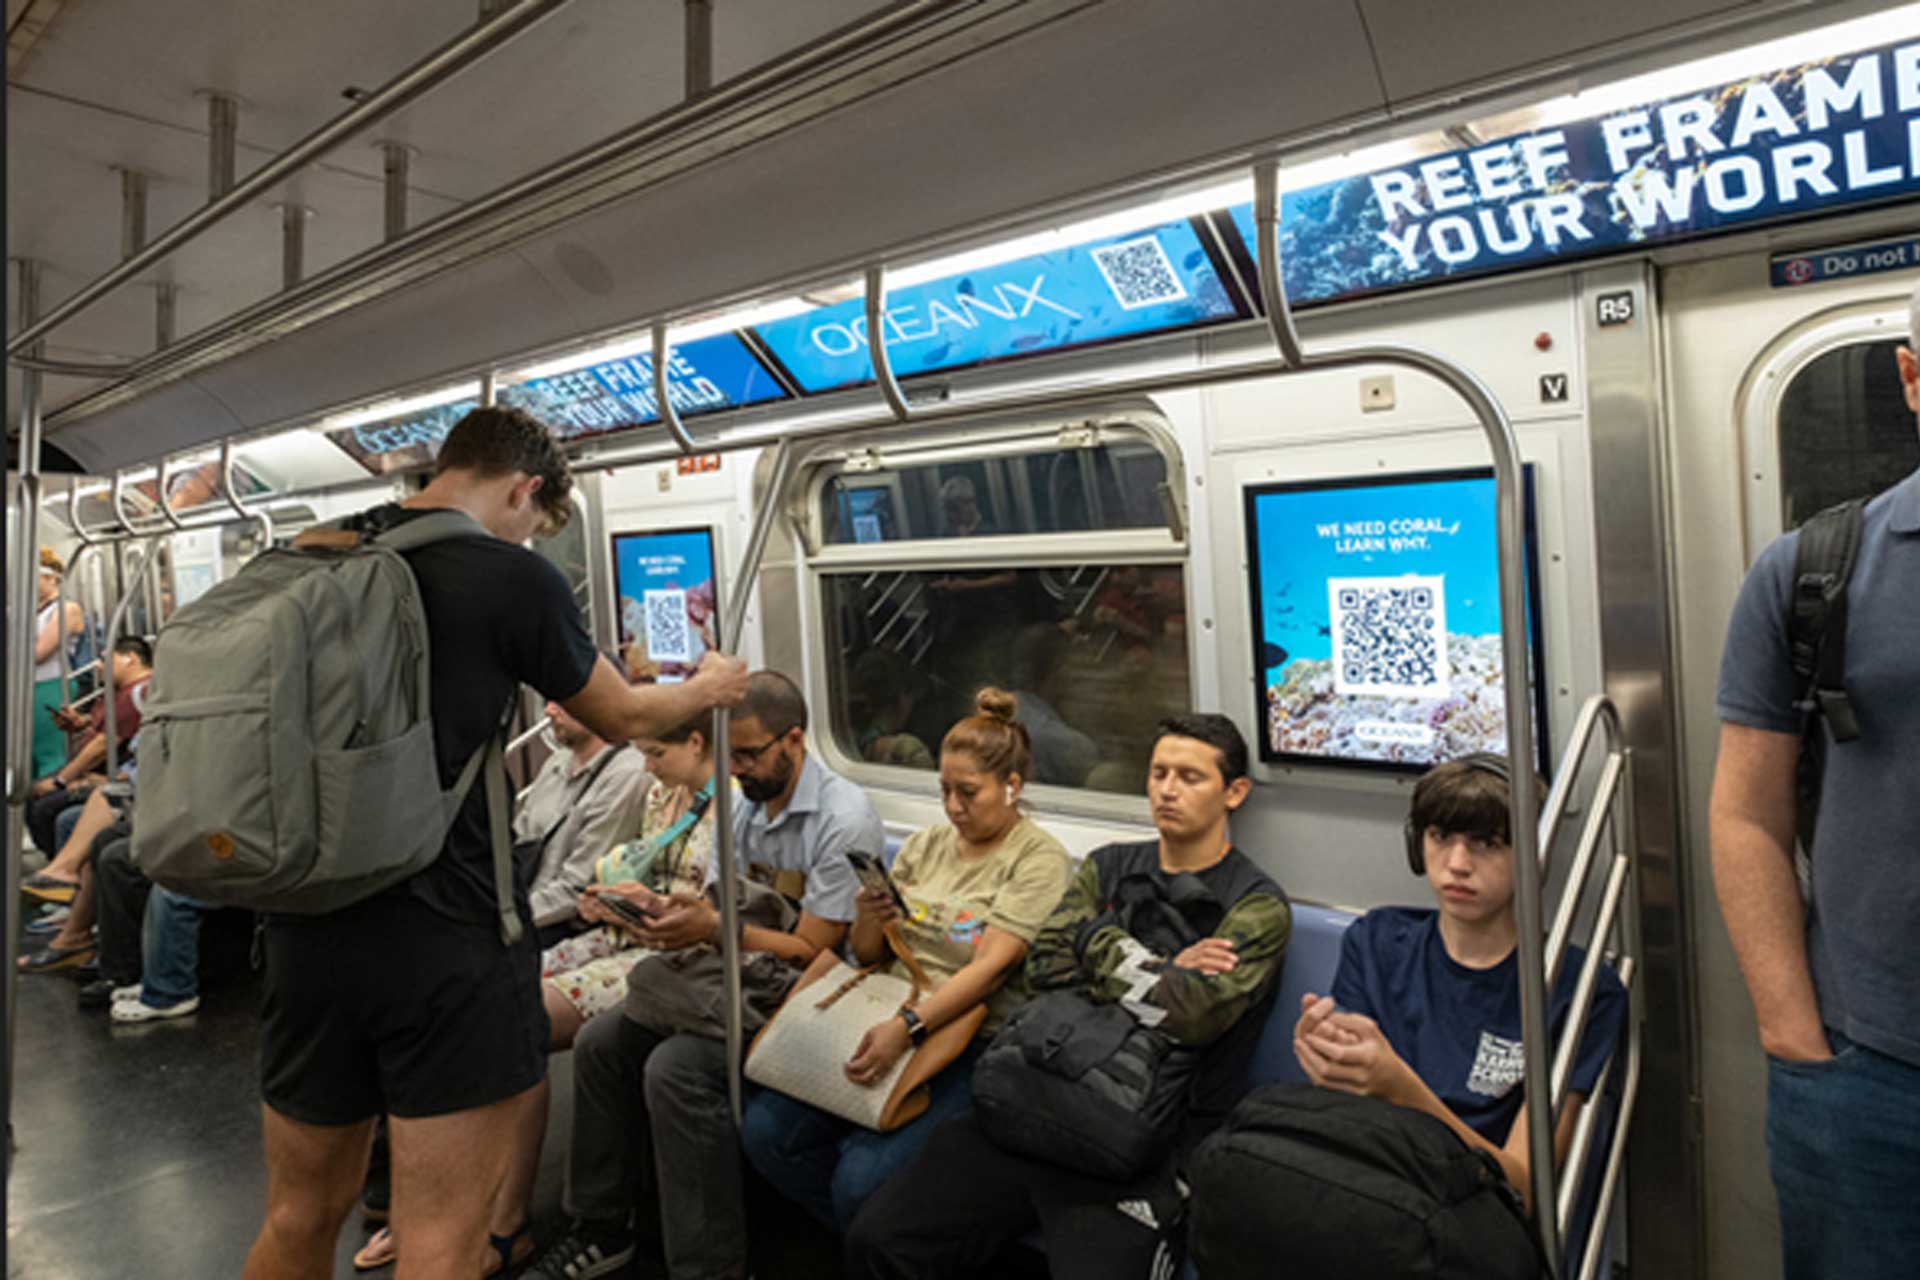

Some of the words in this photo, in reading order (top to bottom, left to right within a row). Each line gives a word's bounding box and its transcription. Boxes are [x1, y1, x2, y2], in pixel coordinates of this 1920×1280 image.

[1370, 131, 1569, 221] REEF
[1378, 193, 1594, 271] YOUR
[1612, 118, 1920, 228] WORL
[1823, 256, 1858, 276] Do
[1864, 246, 1906, 269] not
[1600, 298, 1632, 321] R5
[534, 370, 603, 404] REEF
[1544, 377, 1564, 399] V
[557, 395, 633, 428] YOUR
[1316, 522, 1340, 537] WE
[1344, 520, 1386, 535] NEED
[1335, 537, 1386, 553] LEARN
[1388, 535, 1432, 553] WHY.
